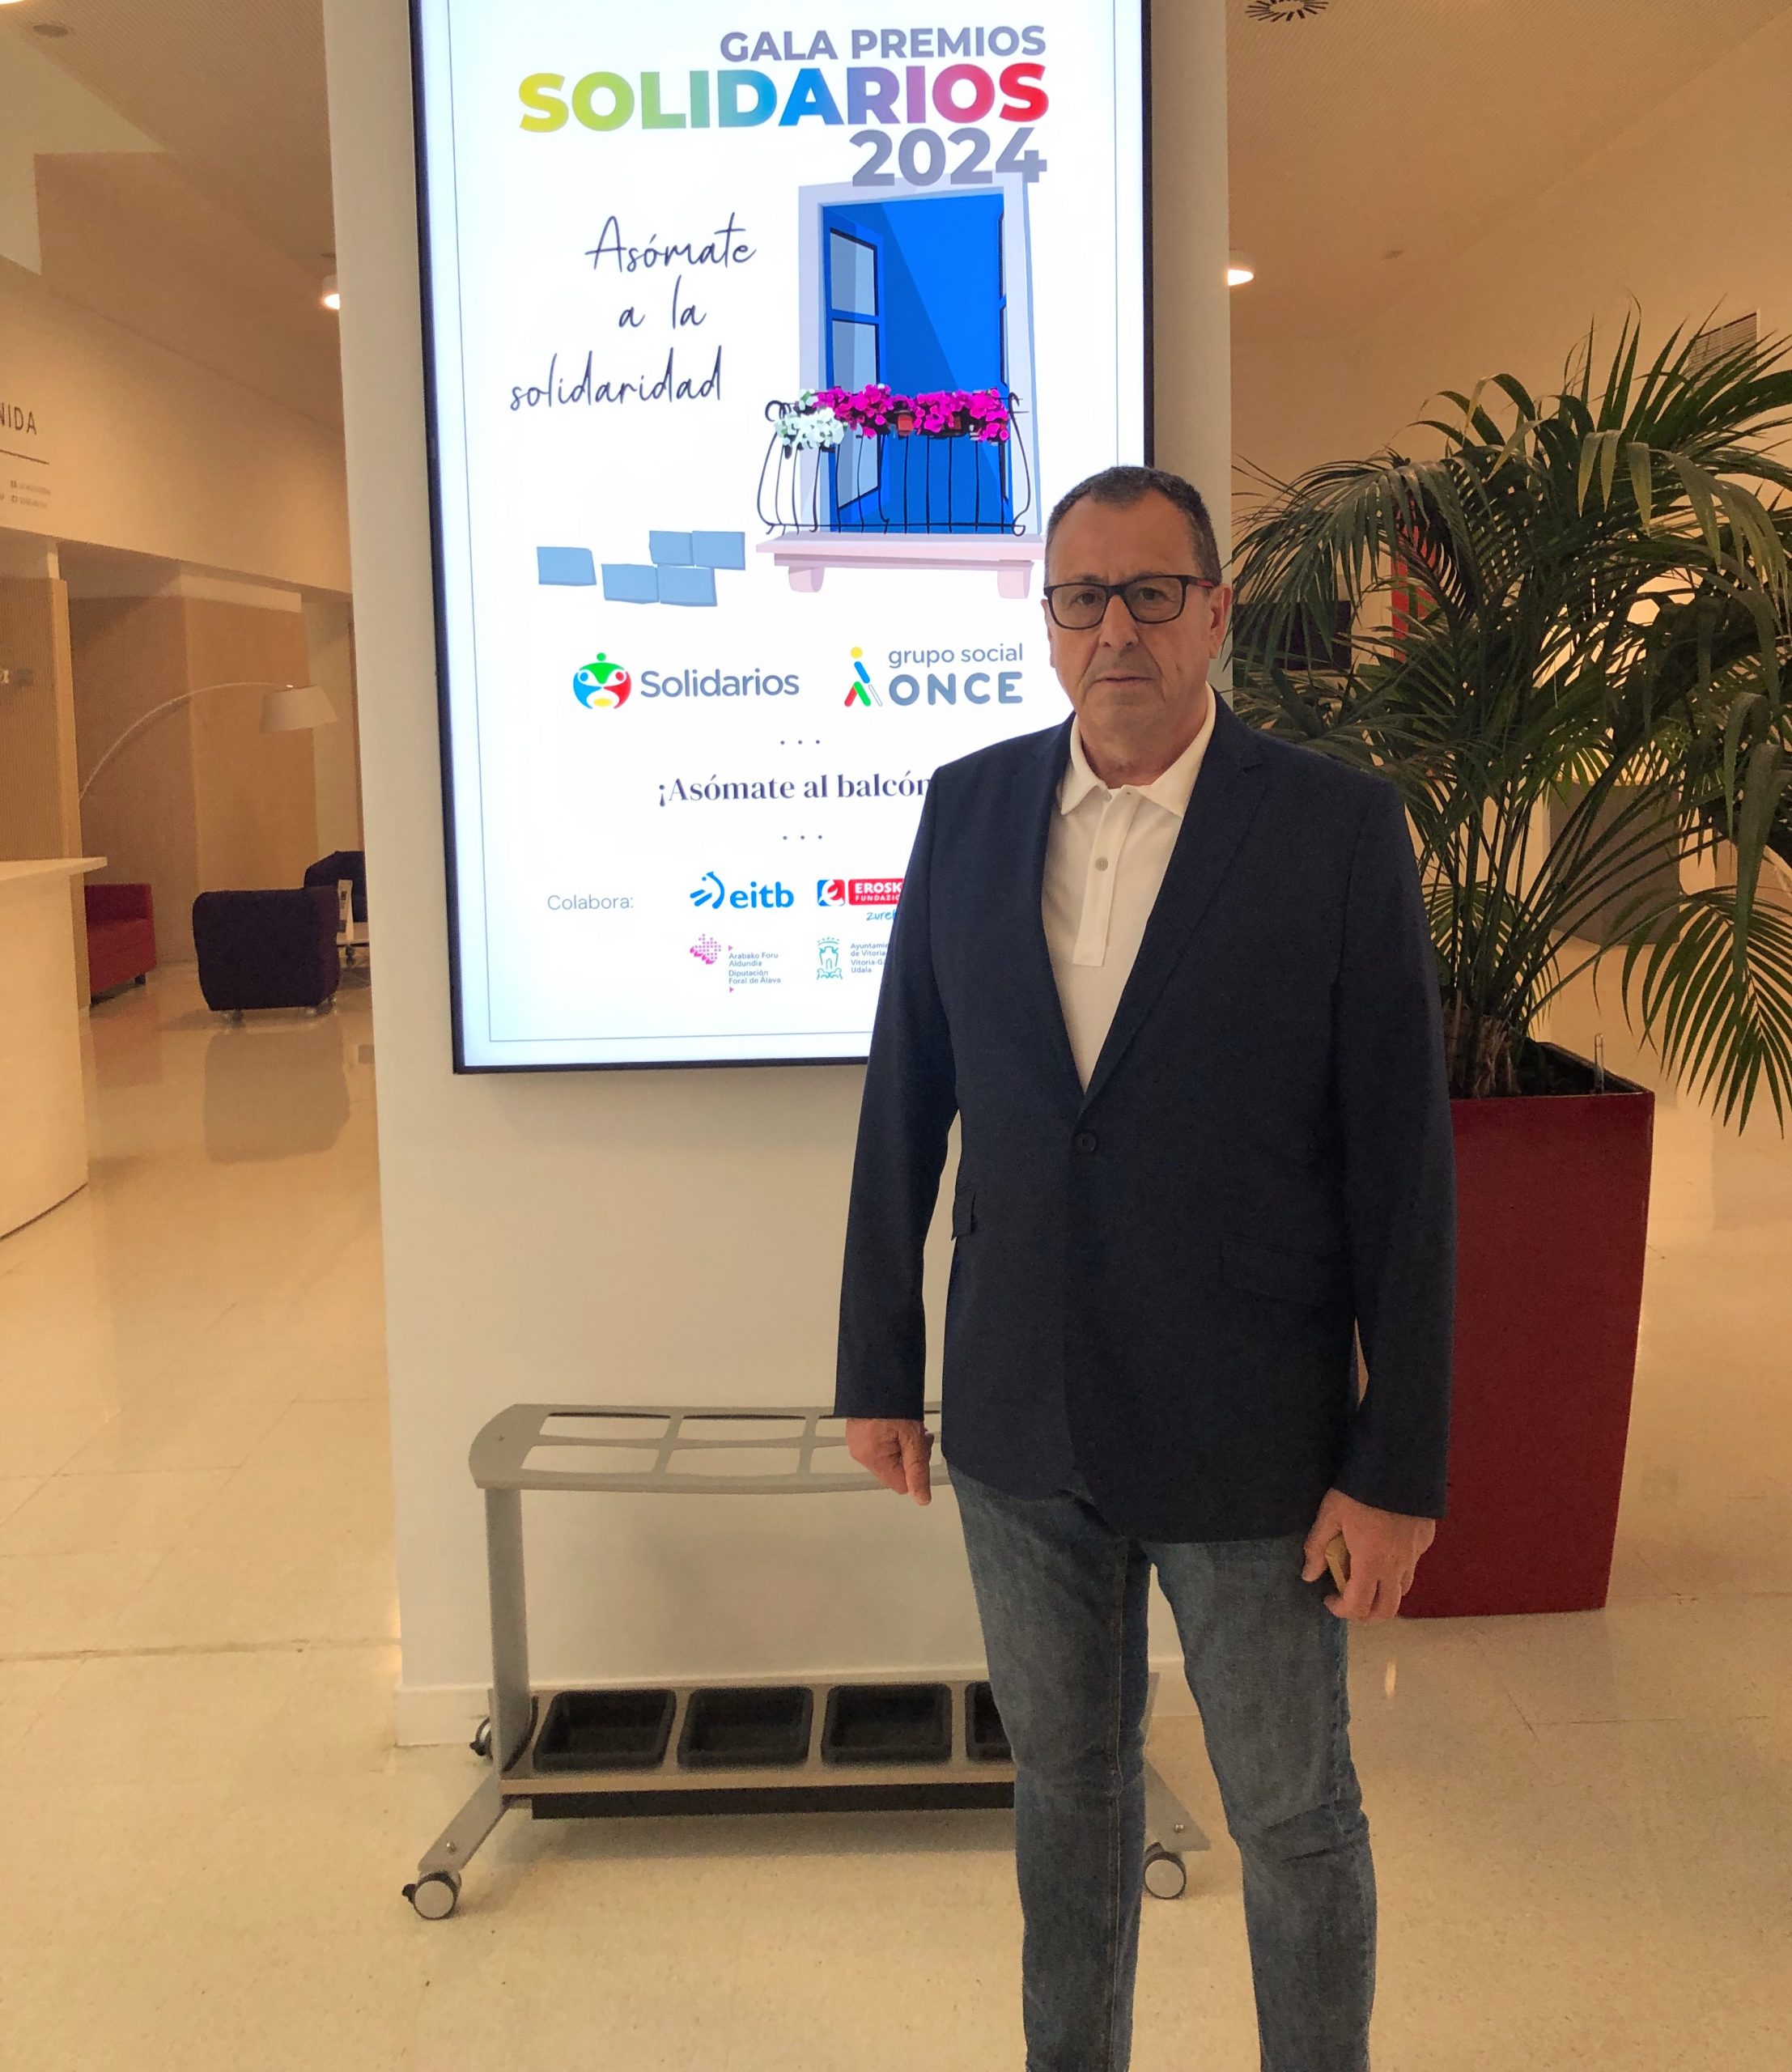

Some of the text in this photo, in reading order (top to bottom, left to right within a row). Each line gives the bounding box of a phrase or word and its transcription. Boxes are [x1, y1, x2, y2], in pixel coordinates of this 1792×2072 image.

[720, 25, 1046, 62] GALA PREMIOS
[519, 62, 1049, 133] SOLIDARIOS
[849, 127, 1047, 187] 2024
[585, 212, 756, 273] Asómate
[619, 274, 707, 329] a la
[511, 346, 722, 411] solidaridad
[889, 643, 1023, 669] grupo social
[641, 668, 800, 698] Solidarios
[889, 672, 1024, 706] ONCE
[659, 775, 795, 807] ¡Asómate
[804, 775, 827, 798] al
[548, 894, 634, 911] Colabora:
[729, 881, 795, 909] eitb
[728, 970, 768, 978] Diputación
[760, 975, 781, 983] Álava
